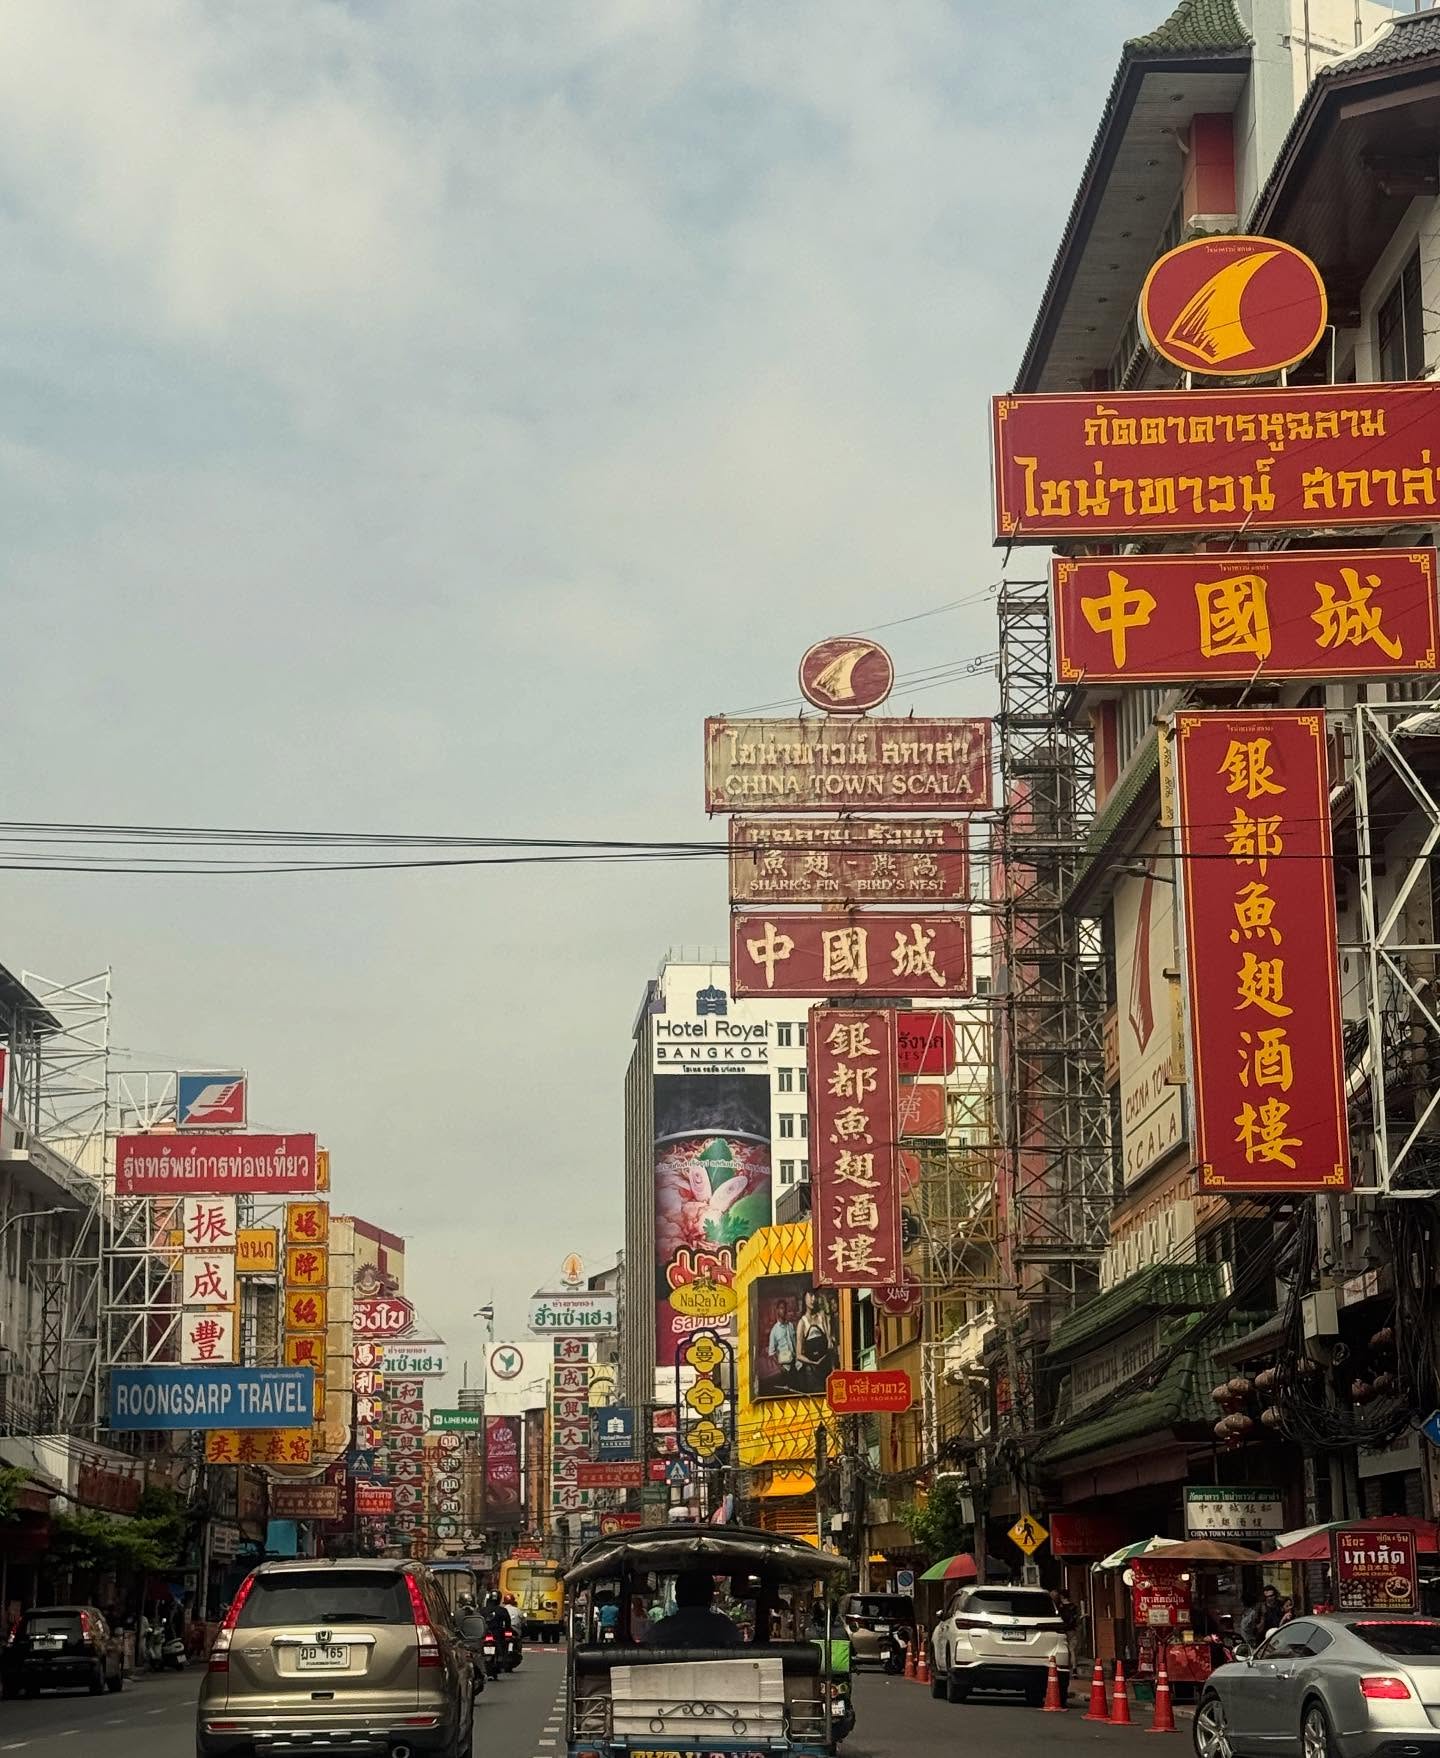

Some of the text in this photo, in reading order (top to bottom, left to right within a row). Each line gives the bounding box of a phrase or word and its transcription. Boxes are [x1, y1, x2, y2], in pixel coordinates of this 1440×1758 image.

[1084, 404, 1386, 450] ภัตตาคารหูฉลาม
[1013, 449, 1440, 517] ไชน่าทาวน์ สกาล่
[1080, 568, 1404, 669] 中國城
[724, 730, 970, 765] ไชน่าทาวน์ สกาล่า
[726, 774, 974, 794] CHINA TOWN SCALA
[750, 879, 947, 891] SHARK'S FIN BIRD'S NEST
[747, 921, 946, 988] 中國城
[1216, 738, 1304, 1170] 銀都魚翅酒樓
[656, 1019, 768, 1041] Hotel Royal
[656, 1047, 768, 1059] BANGKOK
[1126, 1080, 1150, 1124] CHINA
[123, 1138, 310, 1190] รุ่งทรัพย์การท่องเที่ยว
[824, 1022, 885, 1276] 銀都魚翅酒樓
[1127, 1112, 1177, 1178] SCALA
[187, 1204, 233, 1361] 振成豐
[680, 1293, 726, 1308] NaRaYa
[293, 1210, 324, 1421] 塔牌紹興
[353, 1302, 405, 1331] องใบ
[534, 1303, 612, 1326] ฮั่วเซ่งเฮง
[116, 1381, 307, 1415] ROONGSARP TRAVEL
[898, 1382, 907, 1394] 2
[560, 1341, 580, 1507] 和成興大金行
[398, 1383, 416, 1530] 和成興大金行
[1190, 1530, 1208, 1538] CHINA
[1344, 1544, 1406, 1565] เกาลัด
